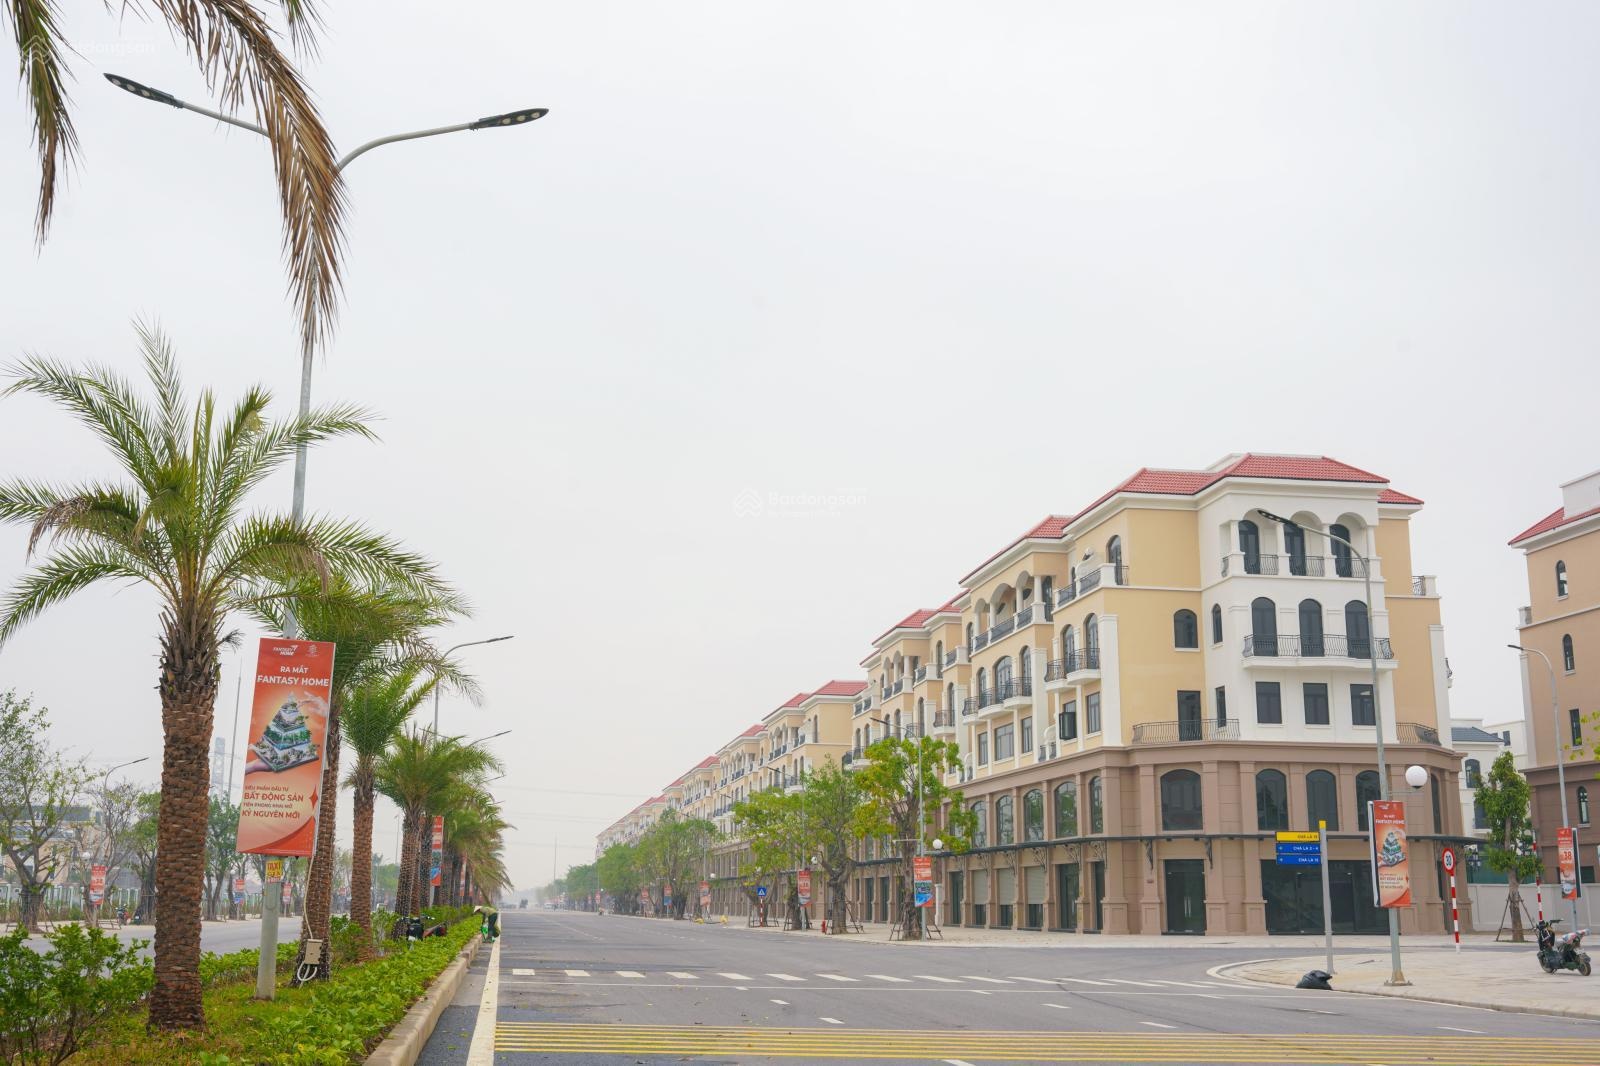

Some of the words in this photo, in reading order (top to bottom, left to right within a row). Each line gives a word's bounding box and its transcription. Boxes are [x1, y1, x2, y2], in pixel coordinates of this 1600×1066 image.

[280, 665, 290, 673] RA
[257, 675, 299, 685] FANTASY
[301, 677, 330, 687] HOME
[244, 790, 260, 800] BẤT
[262, 792, 286, 802] ĐỘNG
[287, 792, 304, 802] SẢN
[242, 808, 252, 816] KỶ
[254, 810, 284, 818] NGUYÊN
[286, 810, 300, 820] MỚI
[1446, 854, 1452, 866] 30
